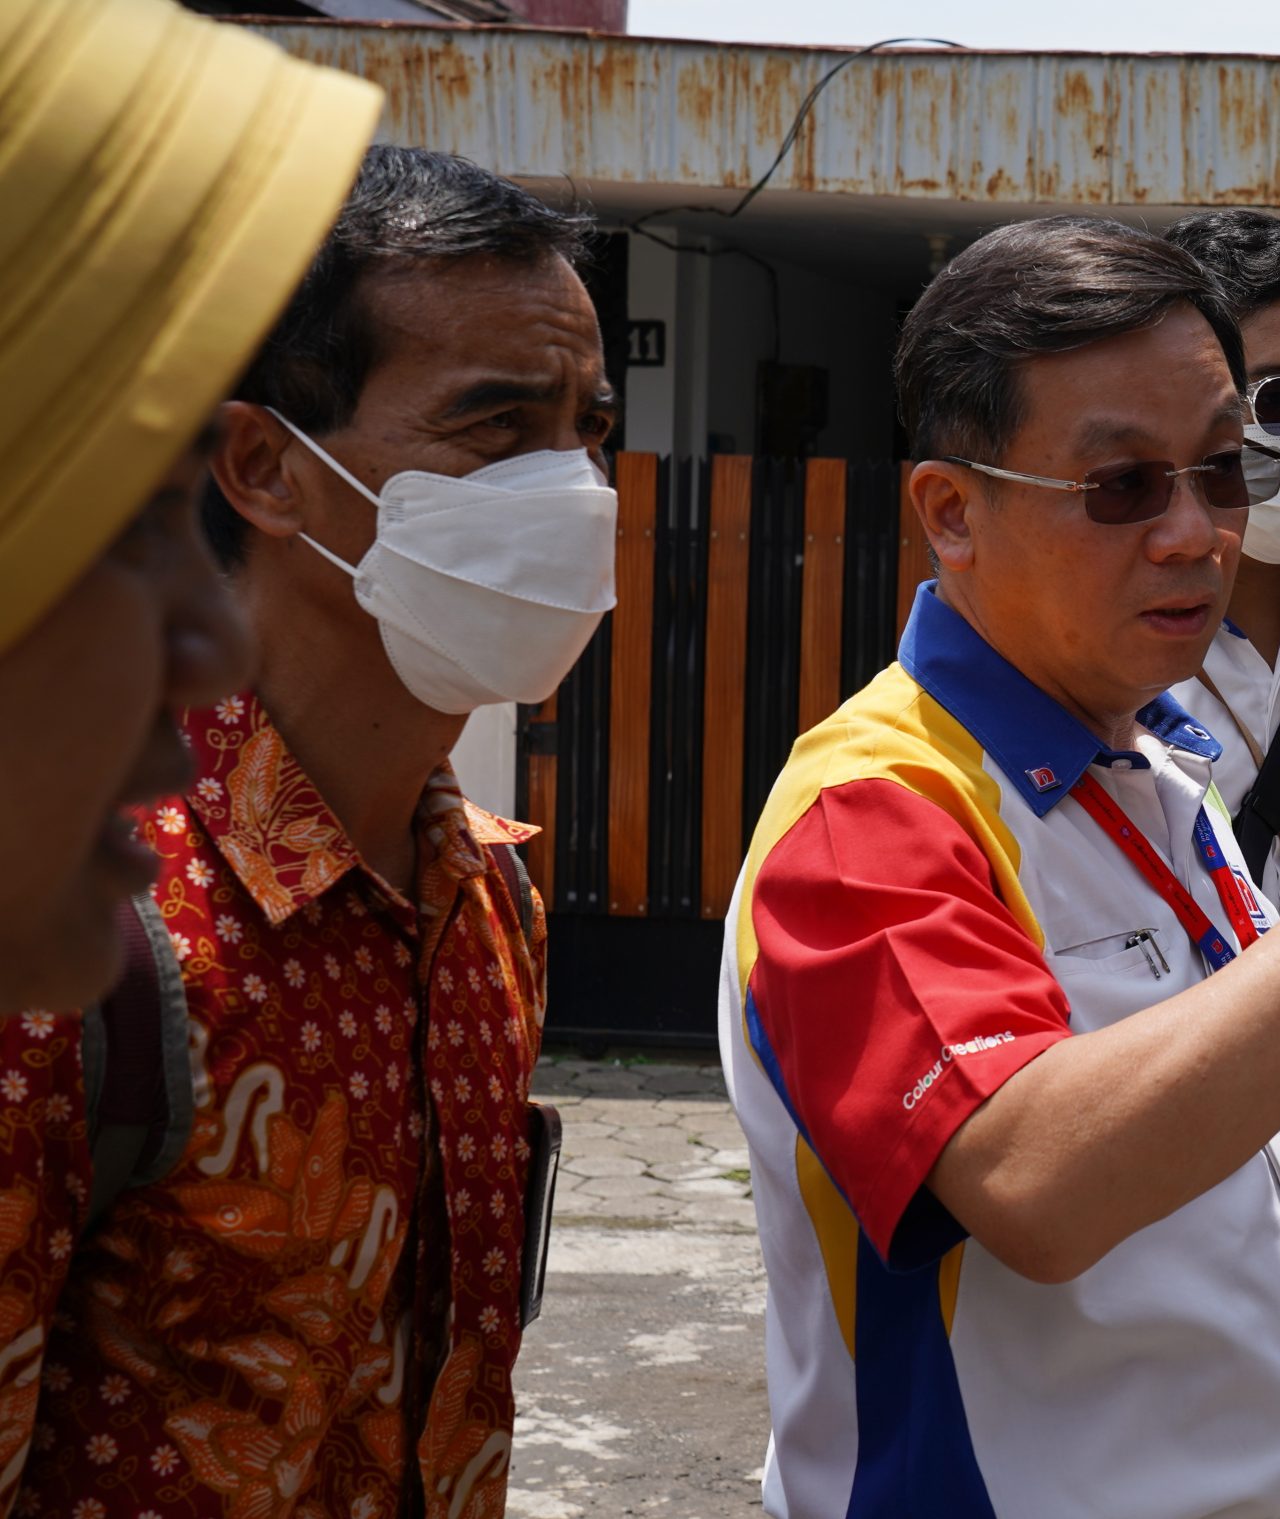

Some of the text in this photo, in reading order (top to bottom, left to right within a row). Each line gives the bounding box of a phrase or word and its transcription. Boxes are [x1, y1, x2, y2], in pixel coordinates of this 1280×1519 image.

[628, 327, 658, 360] 11
[902, 1030, 1016, 1110] Colour Creations
